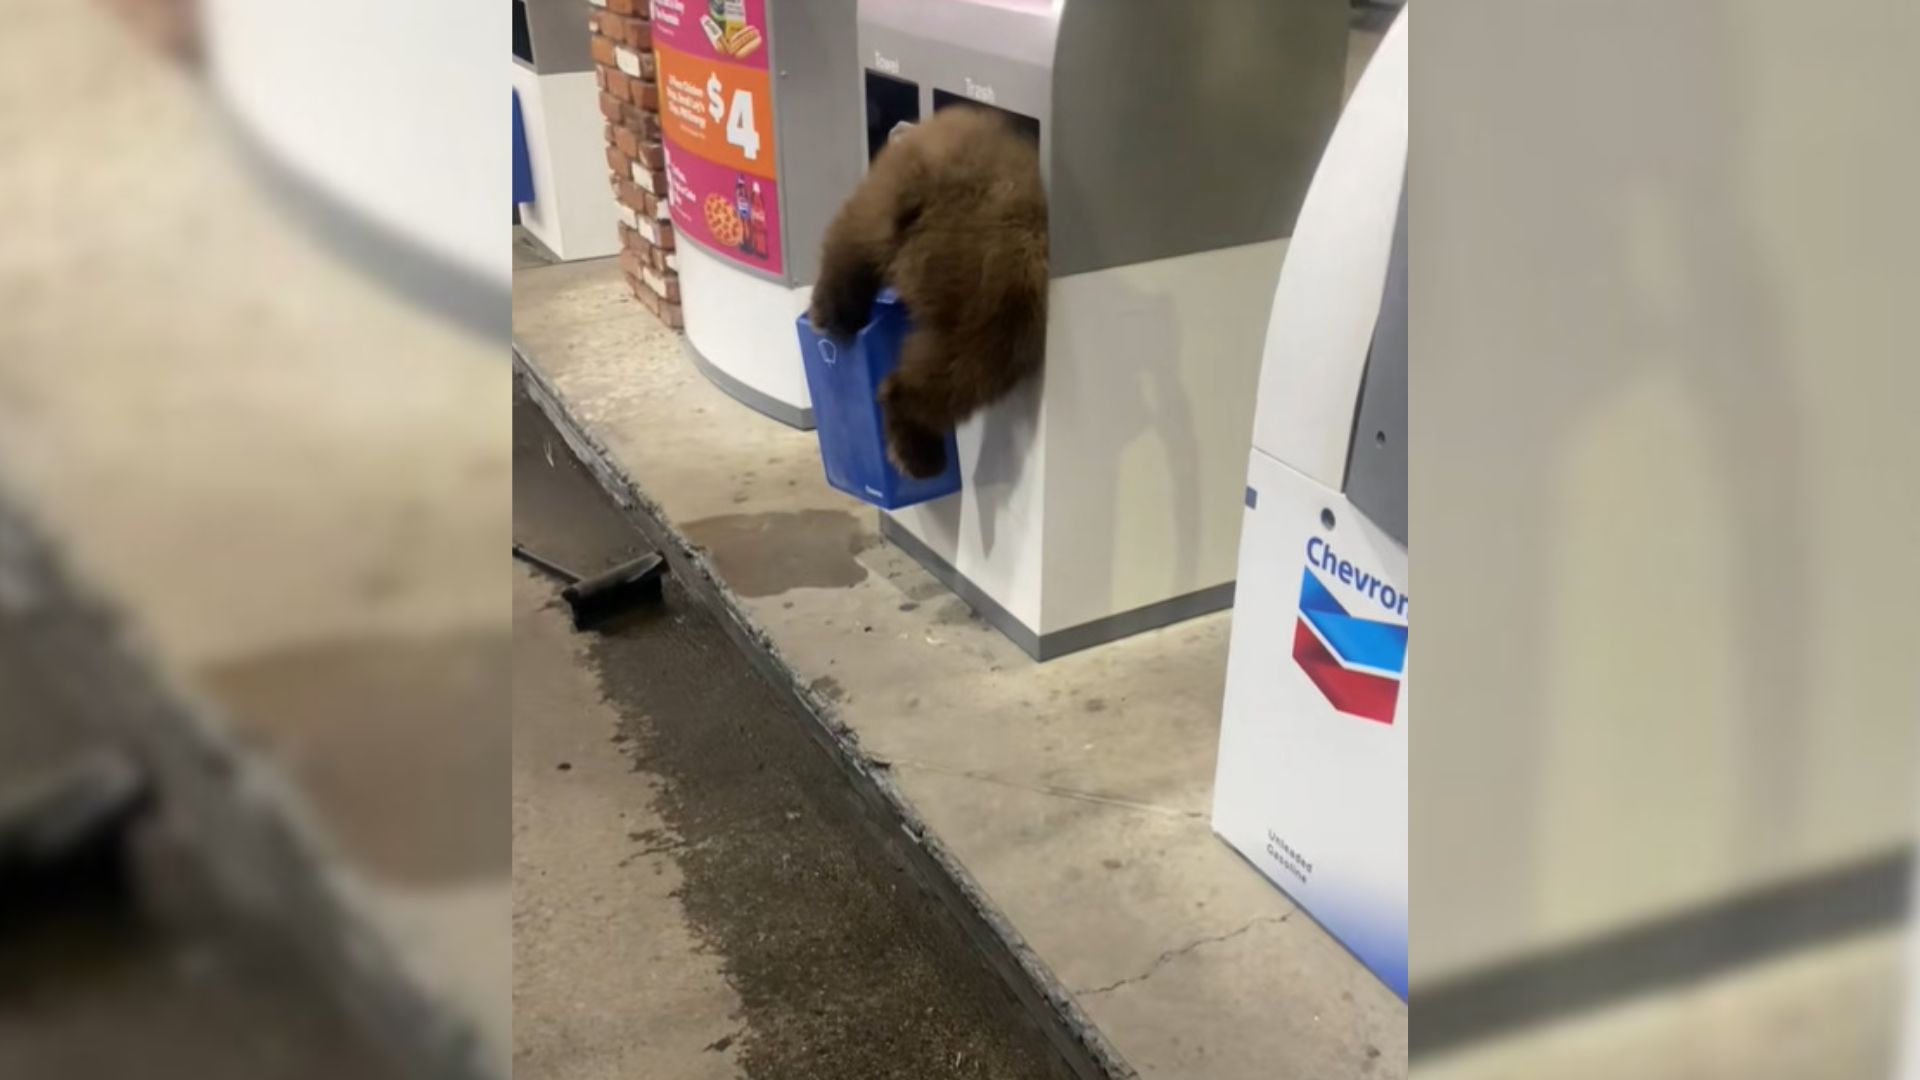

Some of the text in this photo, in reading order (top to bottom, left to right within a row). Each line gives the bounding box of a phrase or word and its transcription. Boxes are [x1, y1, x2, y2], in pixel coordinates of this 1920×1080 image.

[964, 76, 995, 103] Trash
[1266, 843, 1307, 884] Gasoline
[1267, 828, 1312, 874] Unleaded
